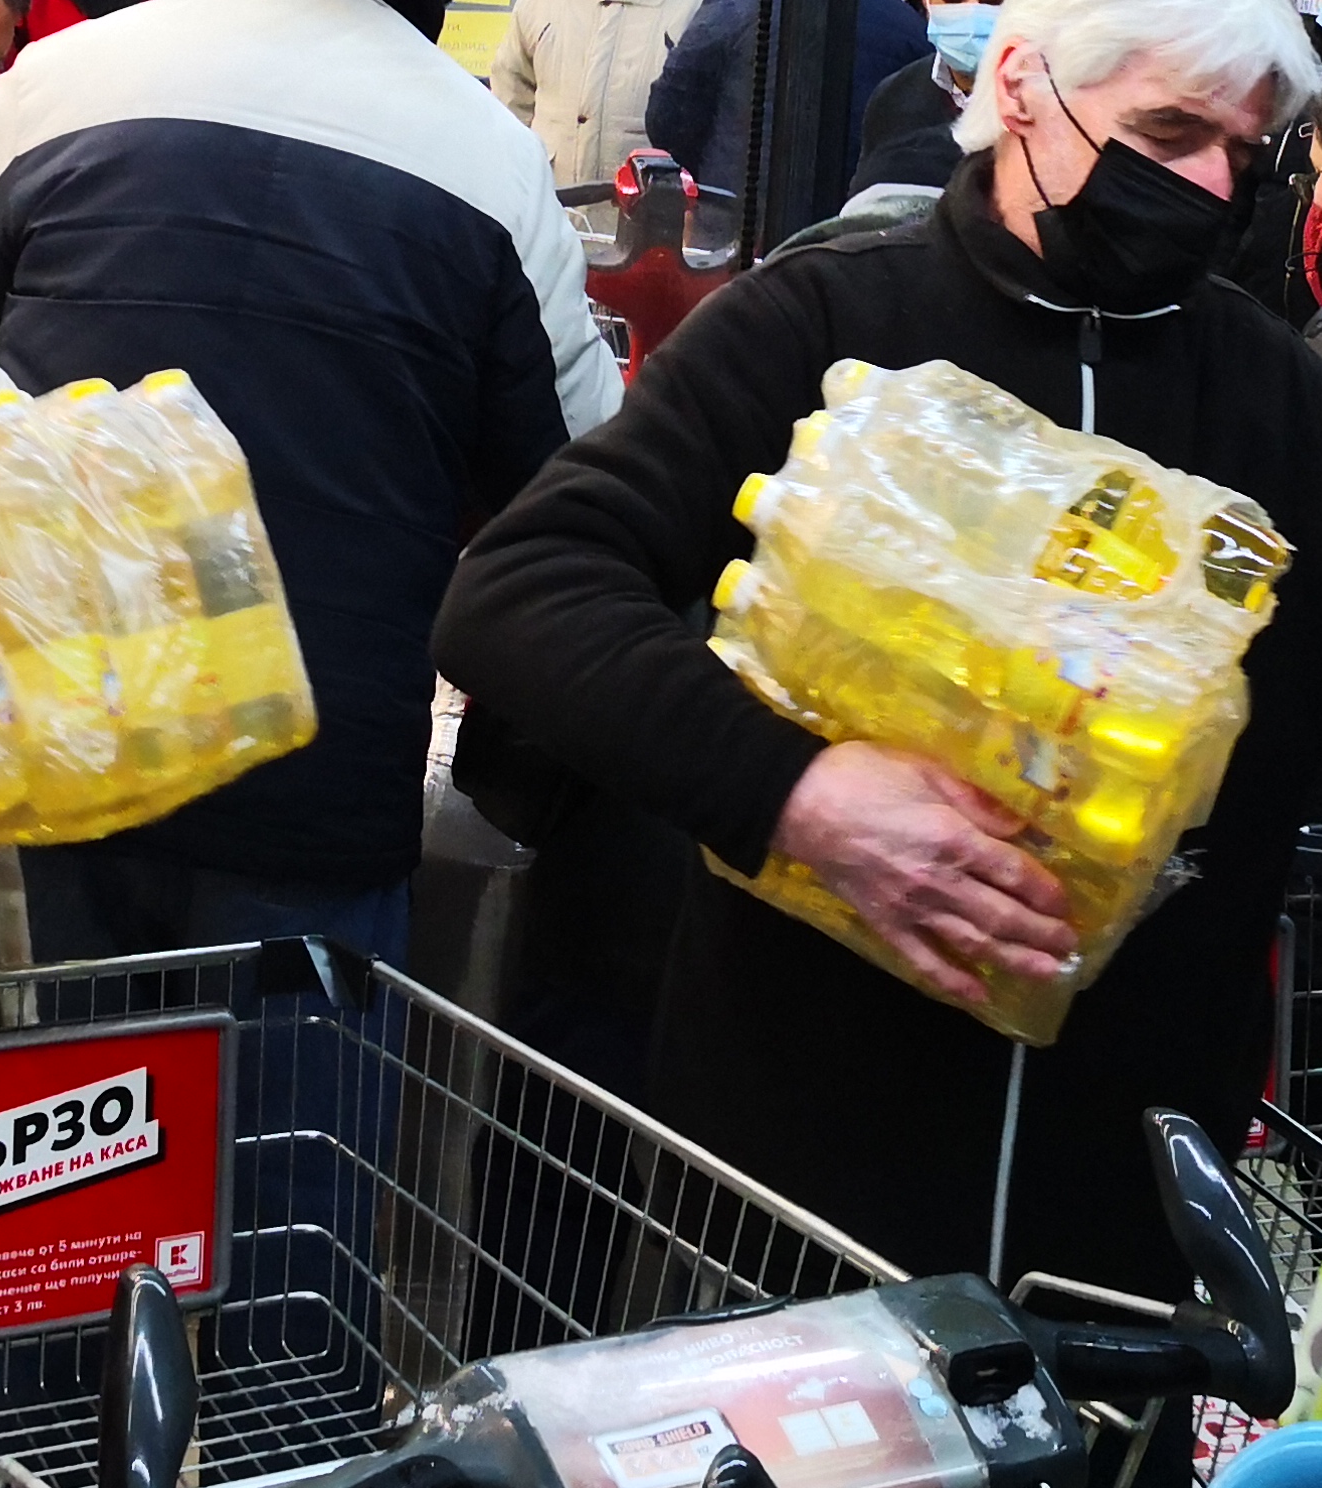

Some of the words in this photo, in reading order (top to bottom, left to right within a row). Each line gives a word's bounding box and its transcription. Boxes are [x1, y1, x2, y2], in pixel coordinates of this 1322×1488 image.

[69, 1149, 95, 1170] НА
[99, 1133, 148, 1162] КАСА
[39, 1244, 54, 1256] от
[58, 1240, 67, 1252] 5
[70, 1234, 122, 1250] минути
[125, 1231, 143, 1243] на
[30, 1262, 47, 1275] са
[50, 1257, 85, 1272] били
[88, 1248, 143, 1265] отворе-
[44, 1278, 67, 1292] ще
[70, 1269, 123, 1287] получи
[14, 1300, 23, 1313] 3
[26, 1298, 46, 1311] лв.
